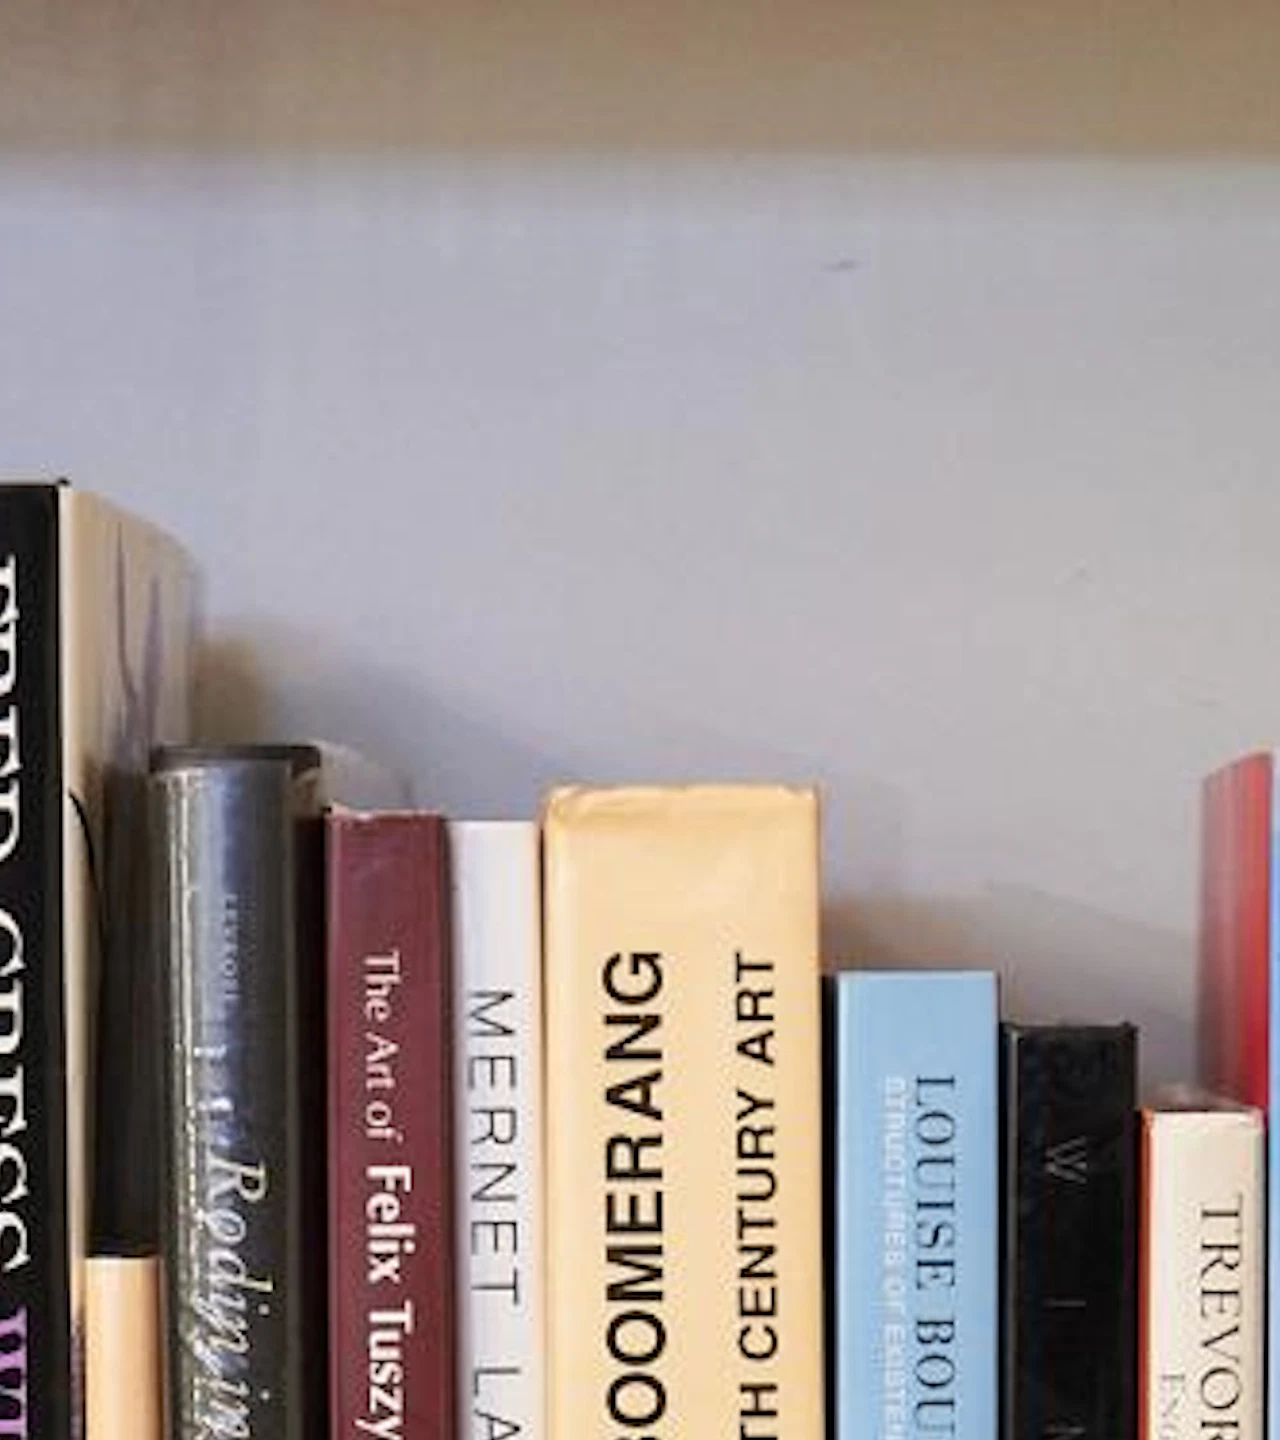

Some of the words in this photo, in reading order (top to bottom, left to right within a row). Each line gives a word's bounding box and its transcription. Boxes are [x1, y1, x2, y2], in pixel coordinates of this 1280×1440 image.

[364, 951, 401, 1021] The
[734, 950, 775, 1066] ART
[365, 1032, 402, 1090] Art
[366, 1101, 403, 1144] of
[470, 988, 522, 1310] MERNET
[366, 1163, 417, 1284] Felix
[735, 1087, 777, 1361] CENTURY
[915, 1075, 957, 1290] LOUISE
